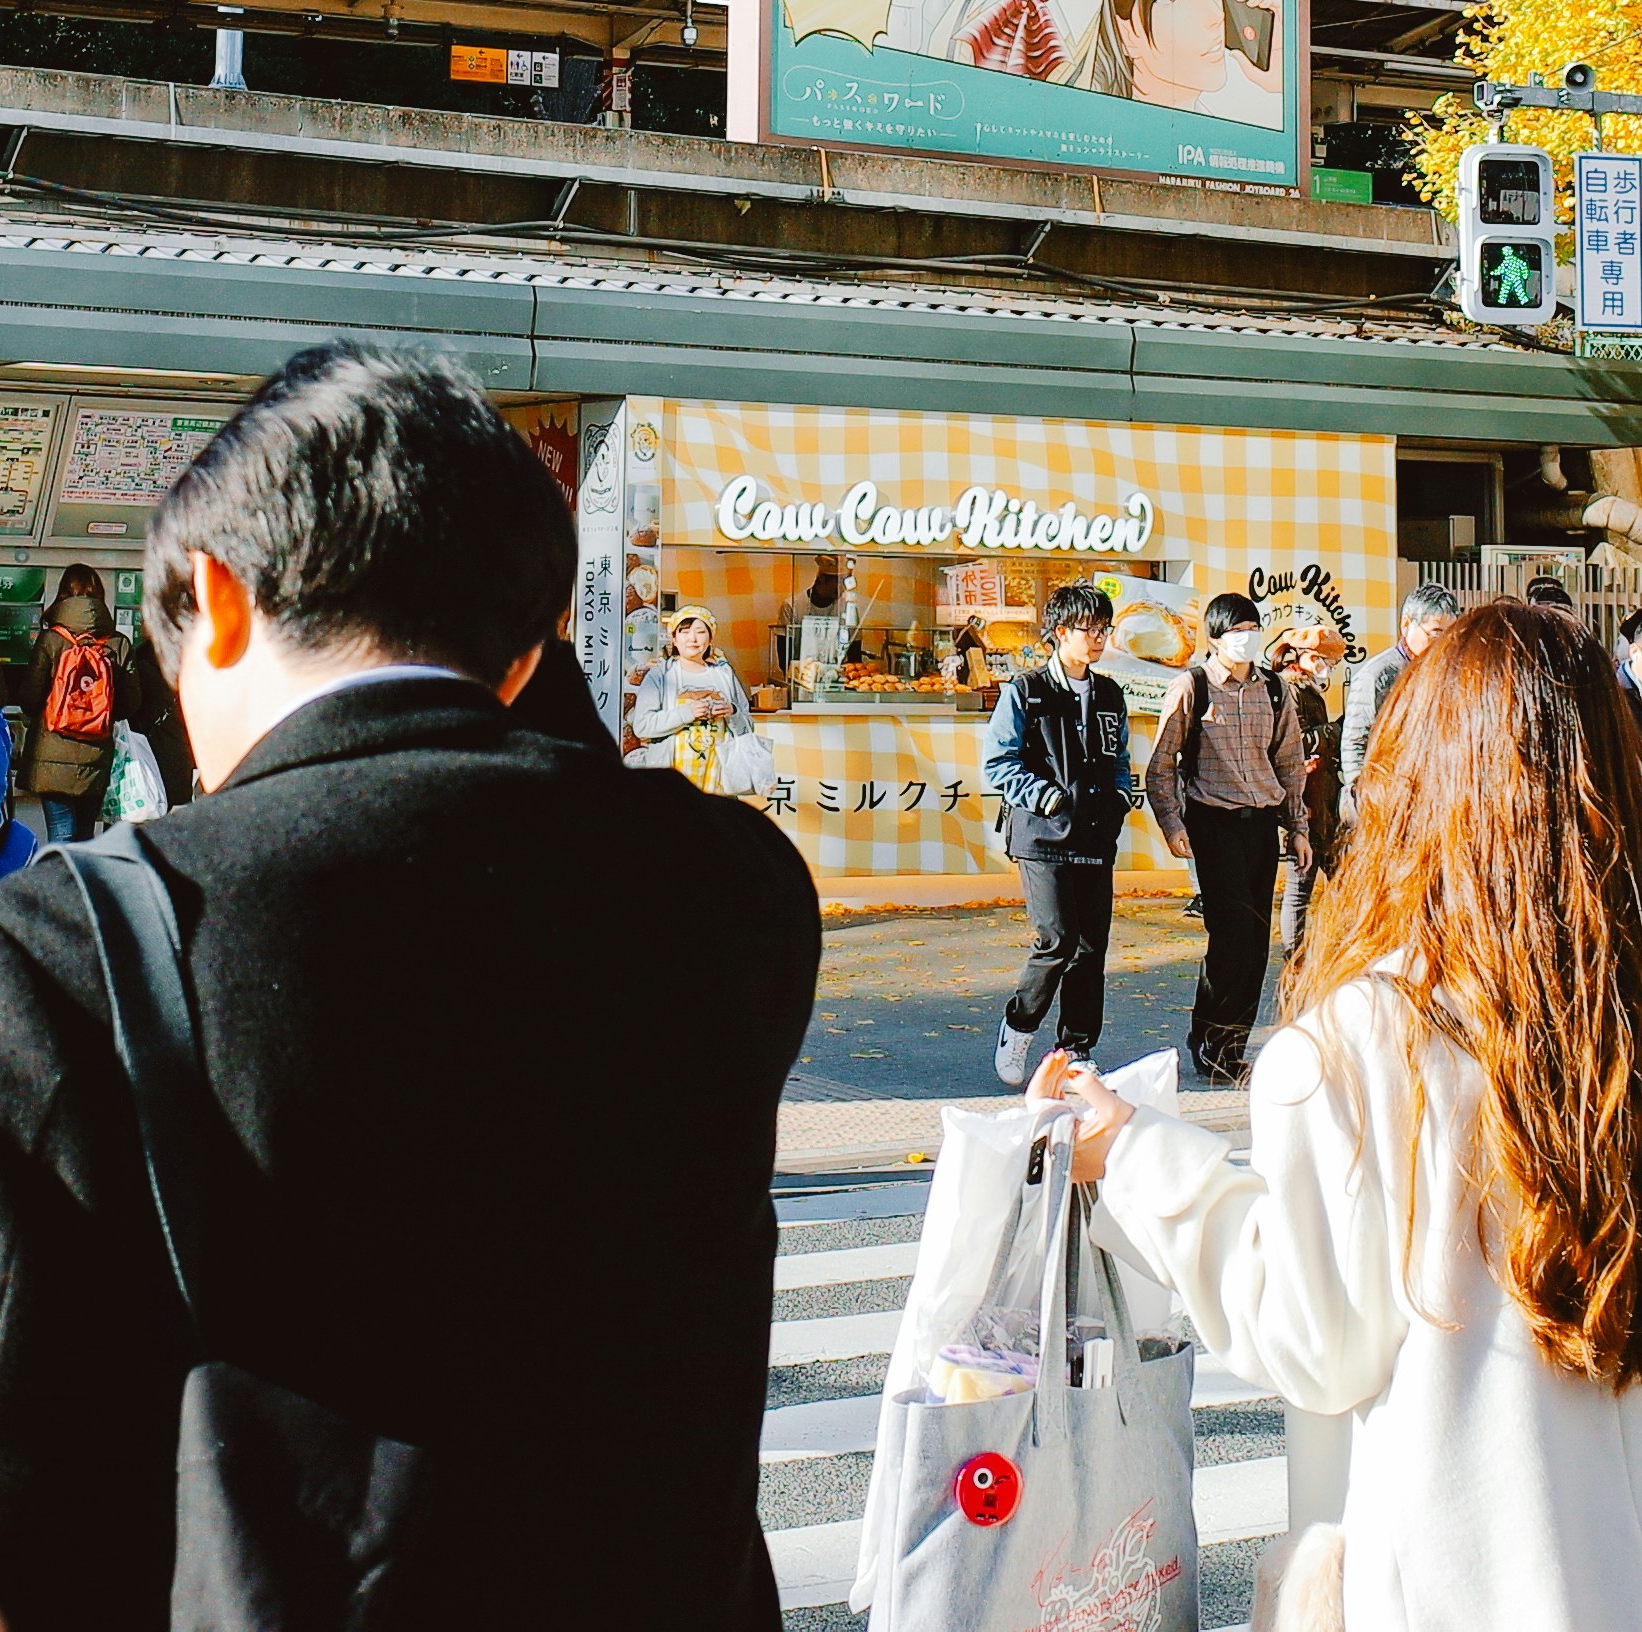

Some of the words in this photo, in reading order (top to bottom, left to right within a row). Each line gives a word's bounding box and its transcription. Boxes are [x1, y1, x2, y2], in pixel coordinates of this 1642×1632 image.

[1177, 144, 1206, 167] IPA
[1585, 168, 1610, 254] 自転車
[1613, 169, 1638, 256] 歩行者
[1600, 259, 1625, 317] 専用
[537, 439, 564, 473] NEW
[718, 474, 837, 542] Cow
[836, 480, 957, 546] Cow
[955, 485, 1154, 553] Kitchen
[584, 558, 596, 622] TOKYO
[1248, 566, 1298, 604] Cow
[1299, 563, 1367, 665] Kitchen
